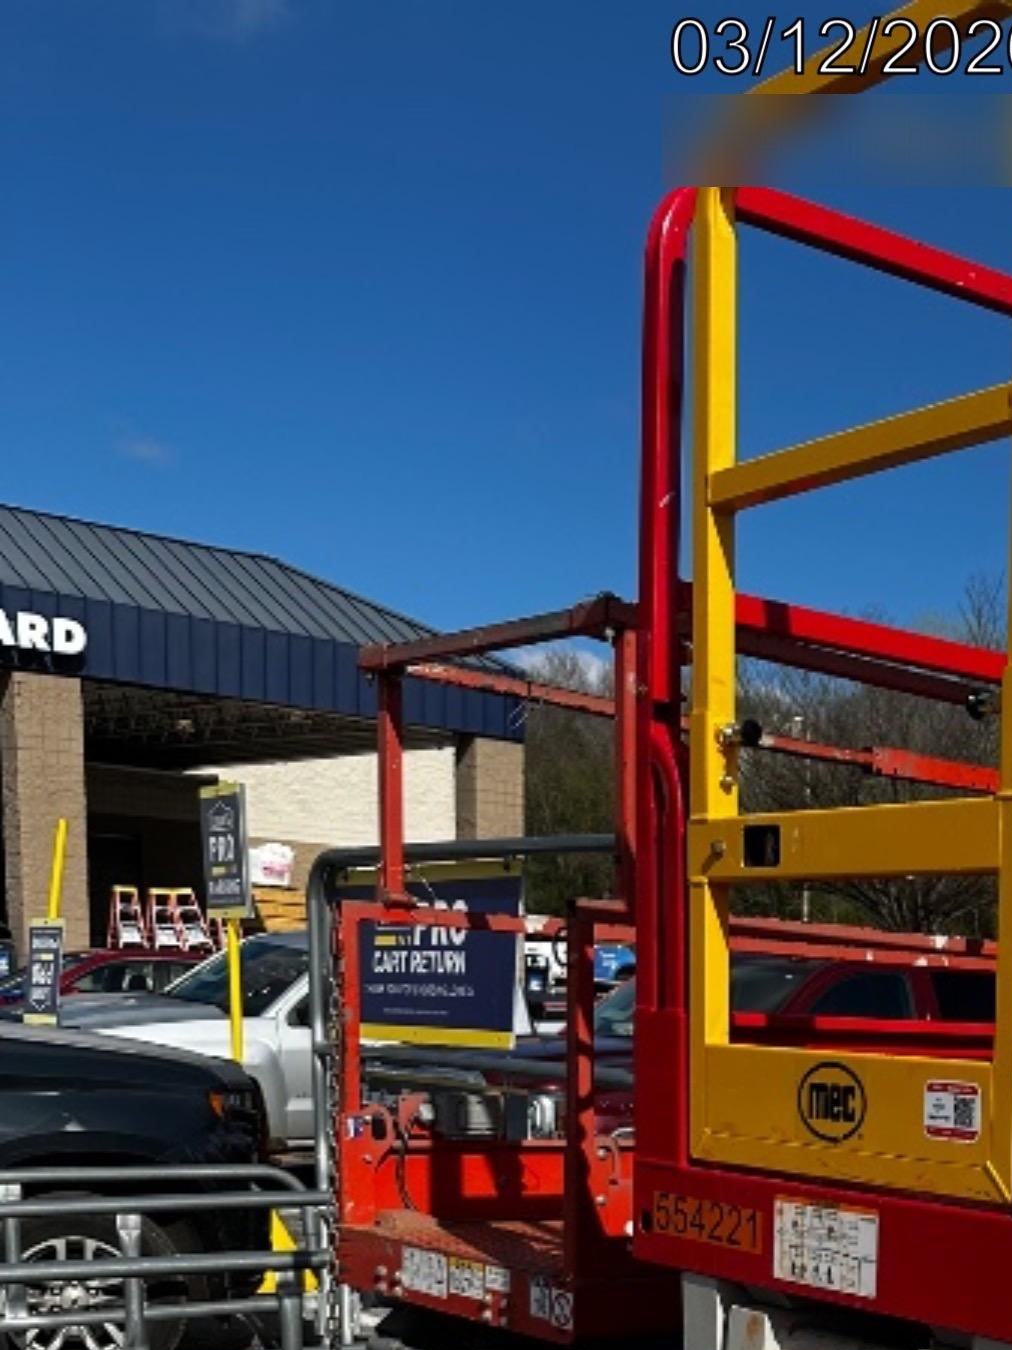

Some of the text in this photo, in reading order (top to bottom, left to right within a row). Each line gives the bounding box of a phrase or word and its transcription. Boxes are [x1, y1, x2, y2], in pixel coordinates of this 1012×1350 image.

[373, 950, 466, 975] CART RETURN
[655, 1192, 759, 1249] 554221
